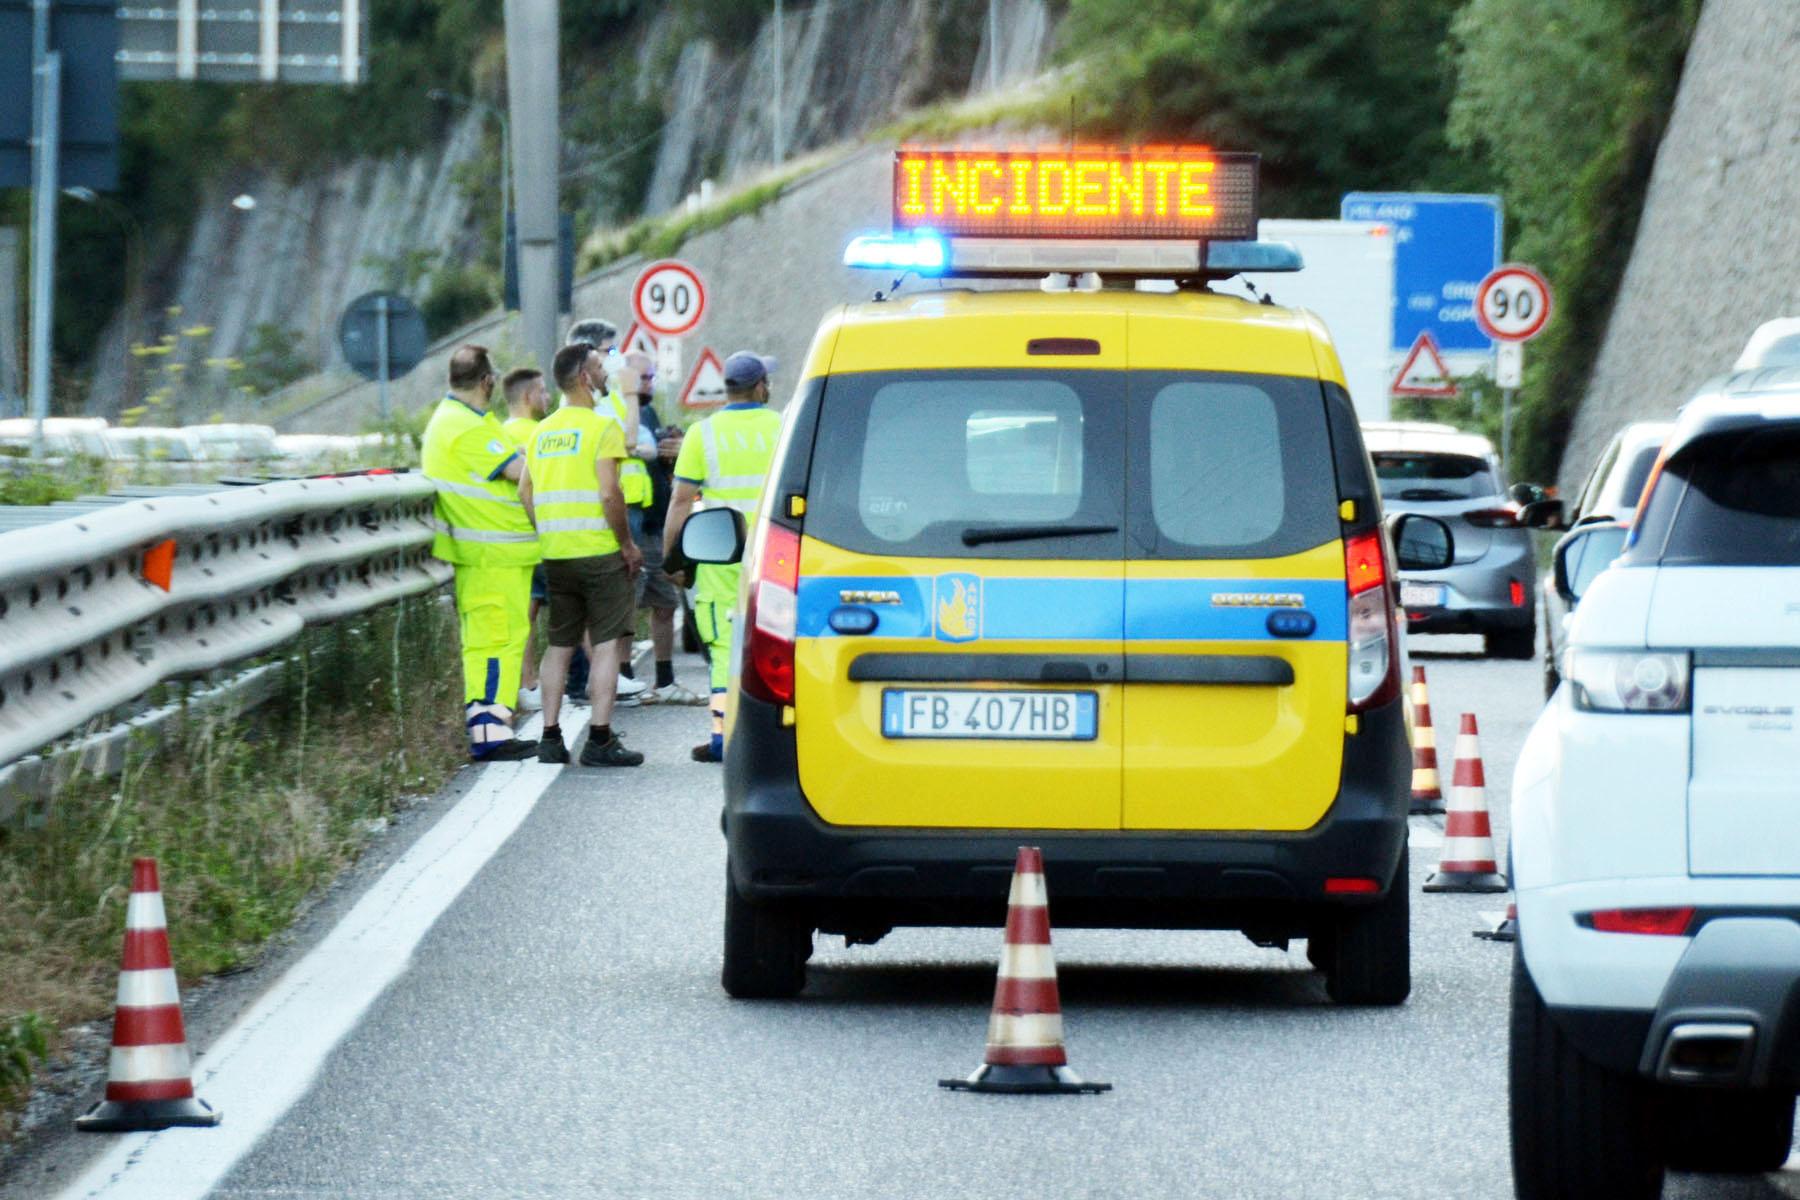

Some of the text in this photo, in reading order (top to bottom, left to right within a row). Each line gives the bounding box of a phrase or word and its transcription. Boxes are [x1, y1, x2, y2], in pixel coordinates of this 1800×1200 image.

[902, 159, 1216, 216] INCIDENTE
[650, 283, 689, 315] 90
[1493, 288, 1534, 320] 90
[909, 694, 1071, 732] FB 407HB
